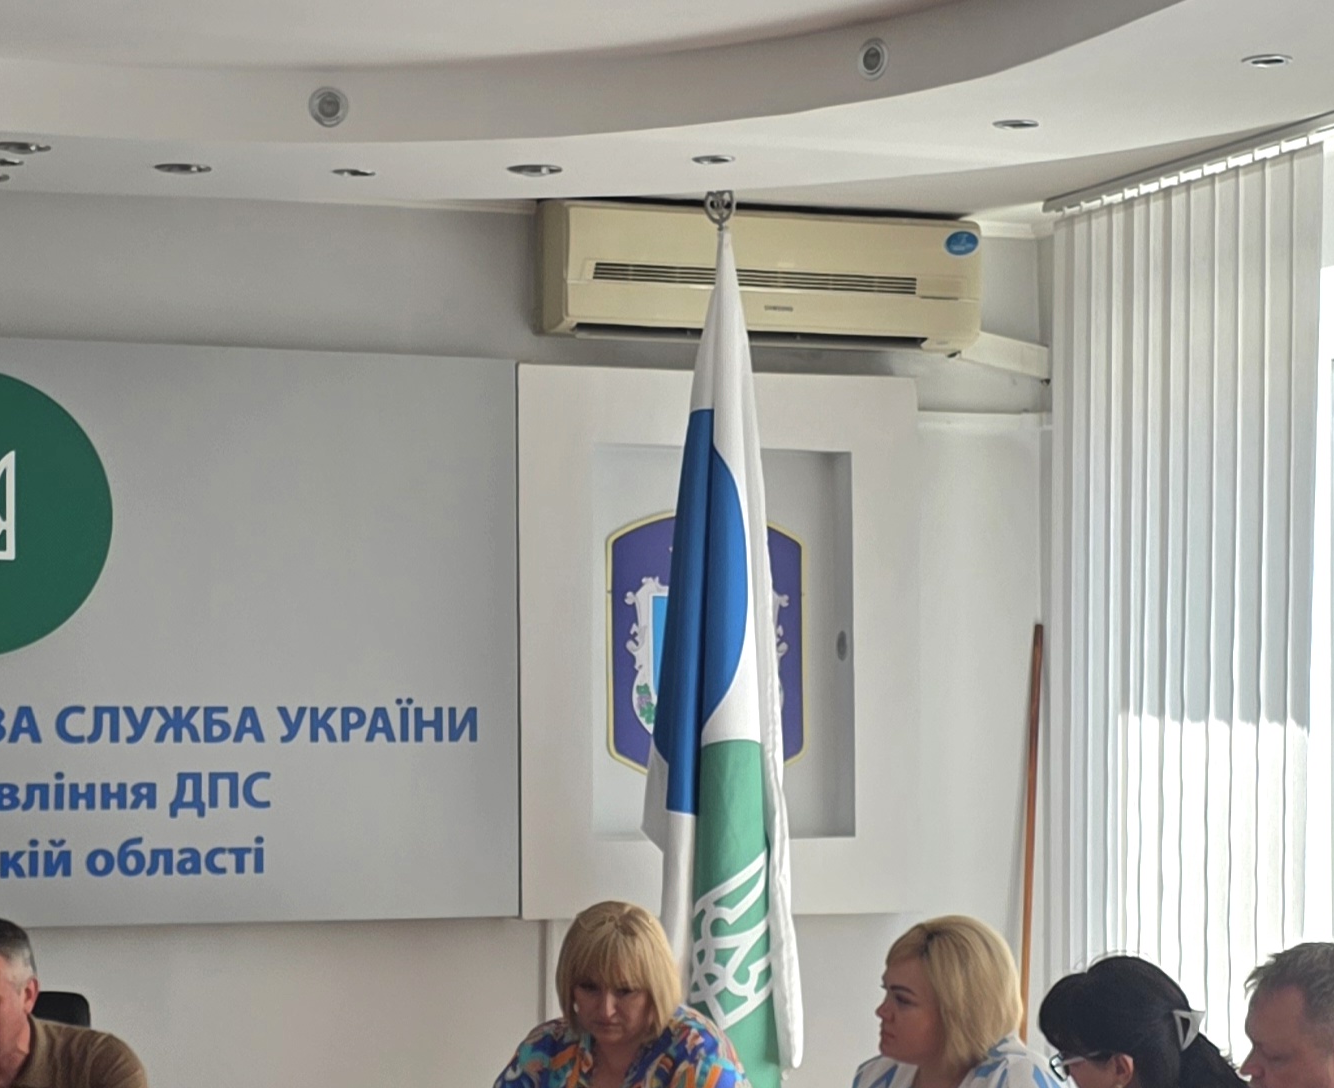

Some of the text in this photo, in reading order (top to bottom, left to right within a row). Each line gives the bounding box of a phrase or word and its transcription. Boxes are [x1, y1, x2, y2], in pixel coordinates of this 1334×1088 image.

[57, 707, 263, 743] СЛУЖБА
[280, 700, 476, 742] УКРАЇНИ
[171, 773, 269, 816] ДПС
[87, 838, 263, 876] області
